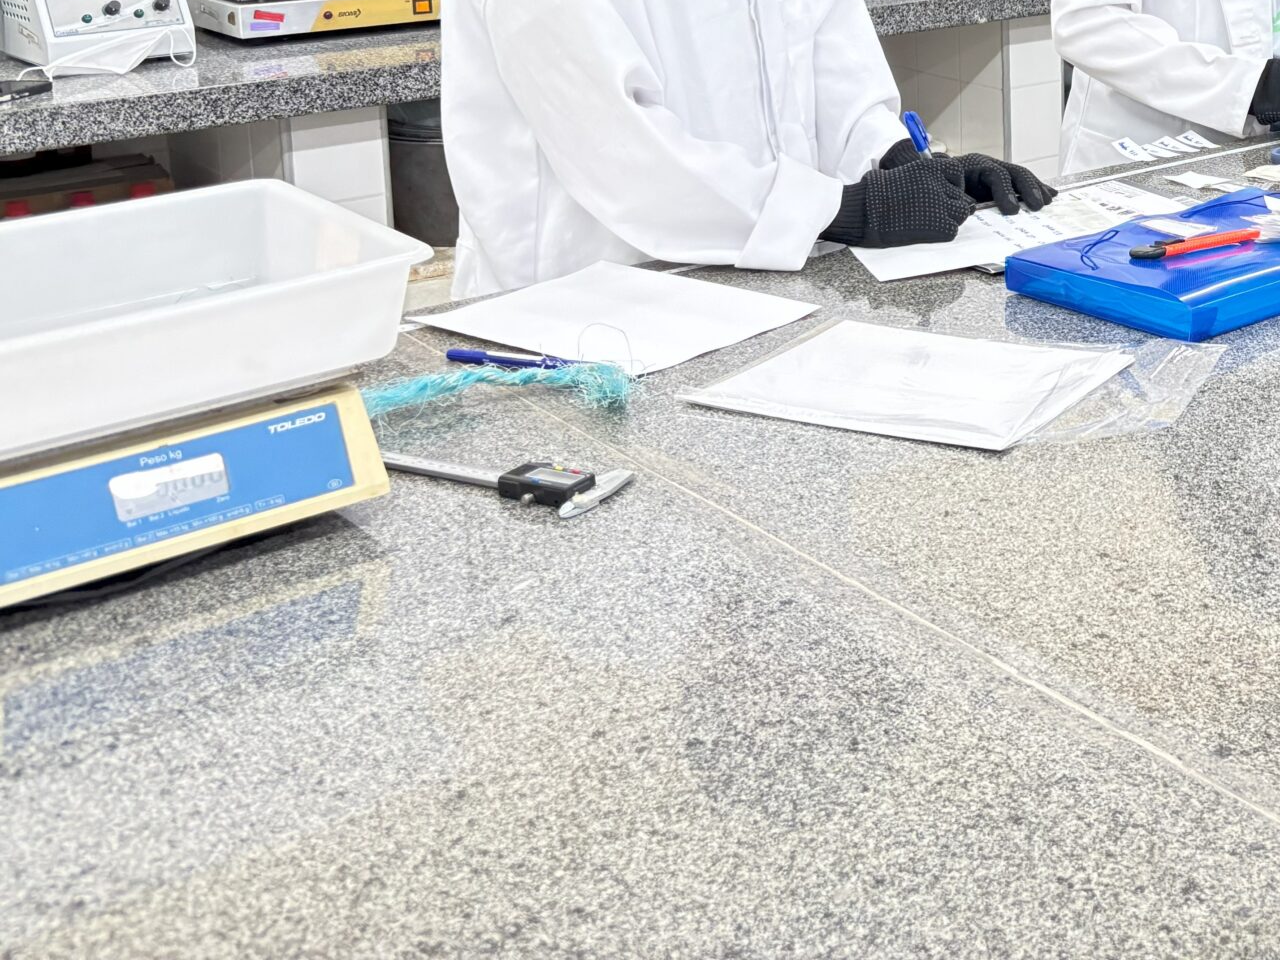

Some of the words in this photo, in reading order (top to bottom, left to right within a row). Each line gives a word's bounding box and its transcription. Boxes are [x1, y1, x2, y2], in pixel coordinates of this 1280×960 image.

[267, 412, 326, 435] TOLEDO
[139, 454, 167, 467] Peso
[169, 449, 183, 460] kg
